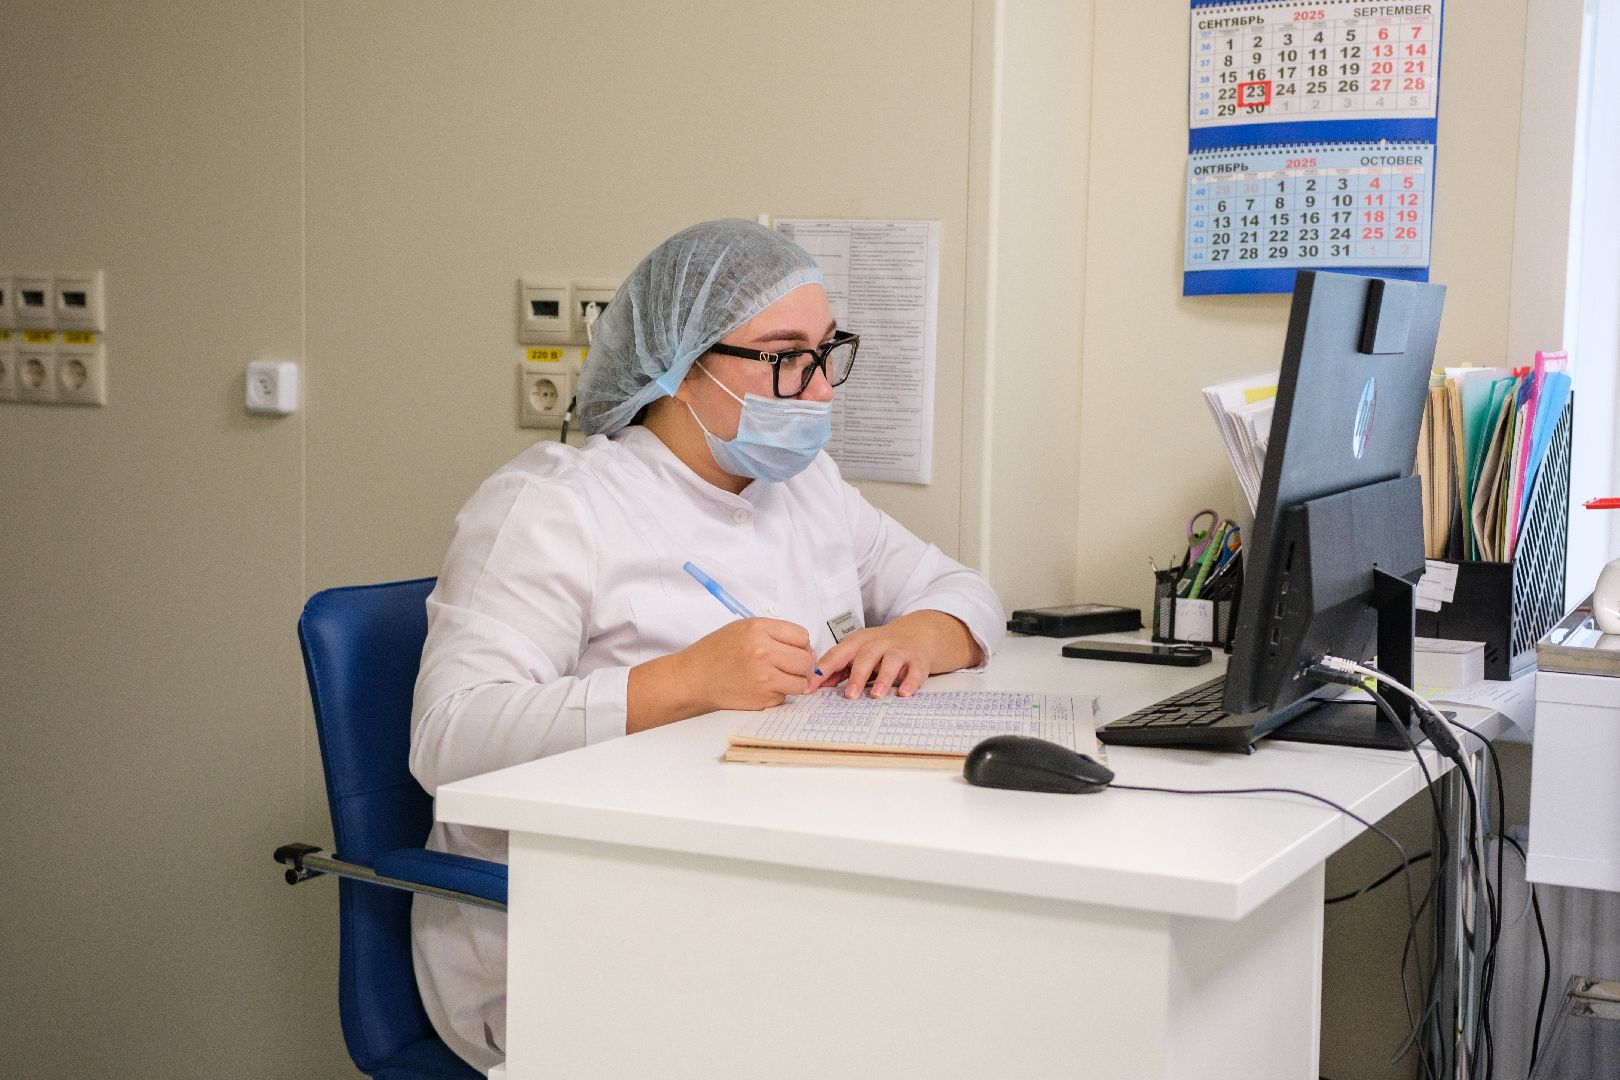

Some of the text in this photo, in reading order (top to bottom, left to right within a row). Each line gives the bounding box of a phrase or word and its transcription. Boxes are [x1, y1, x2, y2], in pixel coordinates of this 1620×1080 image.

[1198, 15, 1265, 30] СЕНТЯБРЬ
[1293, 10, 1325, 21] 2025
[1353, 4, 1432, 17] SEPTEMBER
[1227, 39, 1233, 50] 1
[1253, 36, 1262, 48] 2
[1283, 33, 1292, 46] 3
[1313, 31, 1324, 43] 4
[1346, 29, 1356, 42] 5
[1378, 28, 1388, 40] 6
[1411, 26, 1422, 39] 7
[1224, 55, 1233, 67] 8
[1252, 52, 1262, 64] 9
[1278, 50, 1297, 62] 10
[1309, 48, 1326, 60] 11
[1340, 46, 1360, 59] 12
[1373, 44, 1393, 57] 13
[1405, 44, 1426, 56] 14
[1220, 71, 1237, 84] 15
[1248, 69, 1266, 81] 16
[1277, 66, 1297, 79] 17
[1308, 64, 1328, 77] 18
[1340, 63, 1360, 75] 19
[1371, 62, 1393, 74] 20
[1404, 61, 1424, 73] 21
[1218, 87, 1237, 100] 22
[1246, 85, 1265, 98] 23
[1276, 83, 1296, 96] 24
[1306, 81, 1327, 94] 25
[1338, 80, 1359, 92] 26
[1370, 79, 1392, 91] 27
[1403, 77, 1425, 90] 28
[1218, 104, 1236, 116] 29
[1246, 102, 1265, 114] 30
[1282, 101, 1289, 111] 1
[1311, 99, 1320, 109] 2
[1344, 98, 1352, 108] 3
[1376, 97, 1384, 107] 4
[1409, 96, 1418, 106] 5
[1194, 155, 1423, 175] ОКТЯБРЬ 2025 OCTOBER
[1278, 181, 1284, 192] 1
[1306, 179, 1316, 191] 2
[1338, 178, 1348, 190] 3
[1369, 177, 1380, 189] 4
[1403, 176, 1413, 189] 5
[1218, 200, 1226, 212] 6
[1246, 199, 1255, 210] 7
[1275, 197, 1285, 209] 8
[1305, 196, 1315, 208] 9
[1332, 194, 1352, 207] 10
[1365, 194, 1383, 206] 11
[1397, 193, 1418, 206] 12
[1213, 216, 1231, 229] 13
[1241, 215, 1259, 227] 14
[1270, 213, 1289, 225] 15
[1300, 212, 1320, 224] 16
[1332, 211, 1352, 223] 17
[1364, 210, 1384, 222] 18
[1397, 210, 1417, 222] 19
[1212, 233, 1230, 245] 20
[1240, 231, 1257, 243] 21
[1269, 230, 1288, 242] 22
[1299, 228, 1319, 241] 23
[1330, 228, 1351, 240] 24
[1362, 227, 1384, 239] 25
[1395, 227, 1416, 239] 26
[1212, 249, 1230, 261] 27
[1239, 247, 1258, 260] 28
[1269, 246, 1288, 258] 29
[1299, 245, 1319, 257] 30
[1331, 244, 1349, 257] 31
[532, 350, 549, 359] 220
